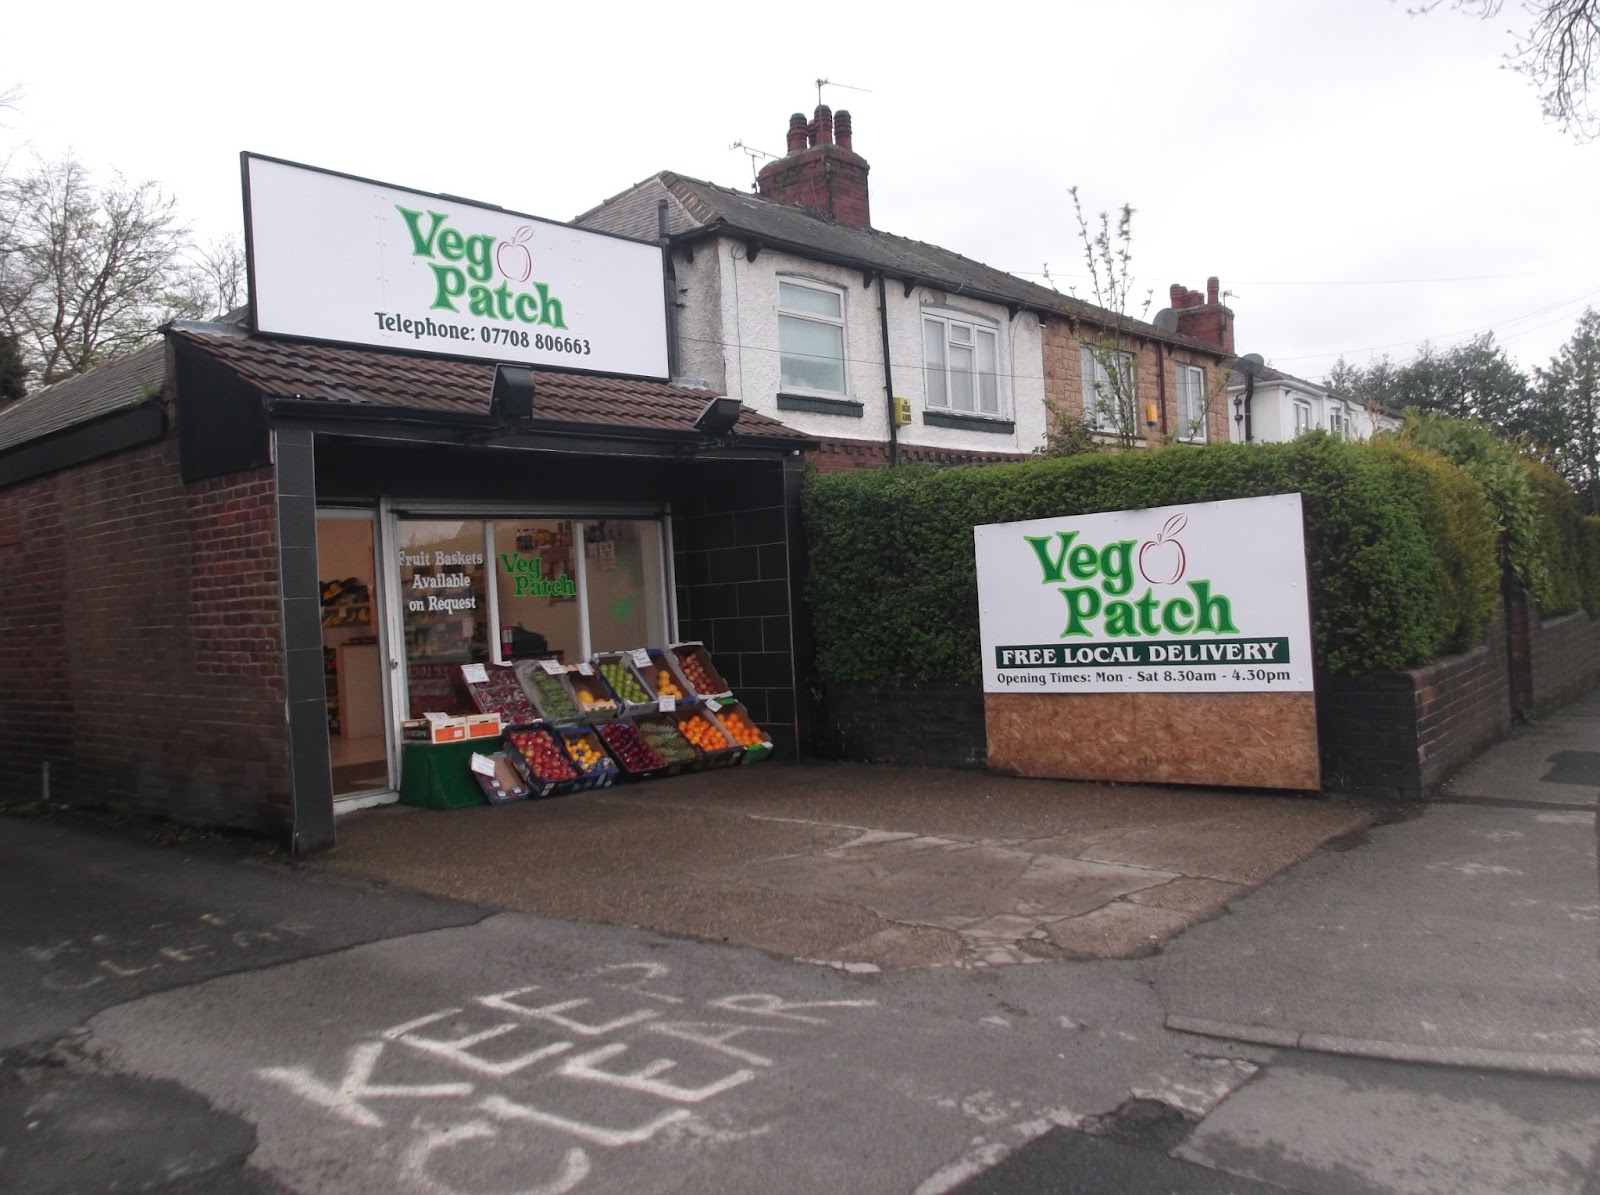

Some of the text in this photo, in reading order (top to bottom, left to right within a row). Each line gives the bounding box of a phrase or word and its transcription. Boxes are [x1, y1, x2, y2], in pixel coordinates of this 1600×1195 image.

[395, 204, 497, 282] Veg
[427, 262, 568, 329] Patch
[374, 312, 591, 355] Telephone: 07708 806663
[399, 551, 482, 566] Fruit Baskets
[501, 552, 542, 581] Veg
[1023, 530, 1138, 596] Veg
[412, 573, 471, 589] Available
[514, 574, 577, 598] Patch
[409, 596, 476, 614] on Request
[1058, 579, 1240, 638] Patch
[1001, 642, 1278, 665] FREE LOCAL DELIVERY
[997, 673, 1046, 685] Opening
[1050, 672, 1091, 683] Times:
[1095, 672, 1123, 682] Mon
[1137, 671, 1159, 682] Sat
[1163, 670, 1217, 682] 8.30am
[1232, 669, 1291, 683] 4.30pm
[256, 961, 684, 1128] KEEP
[404, 993, 877, 1195] CLEAR
